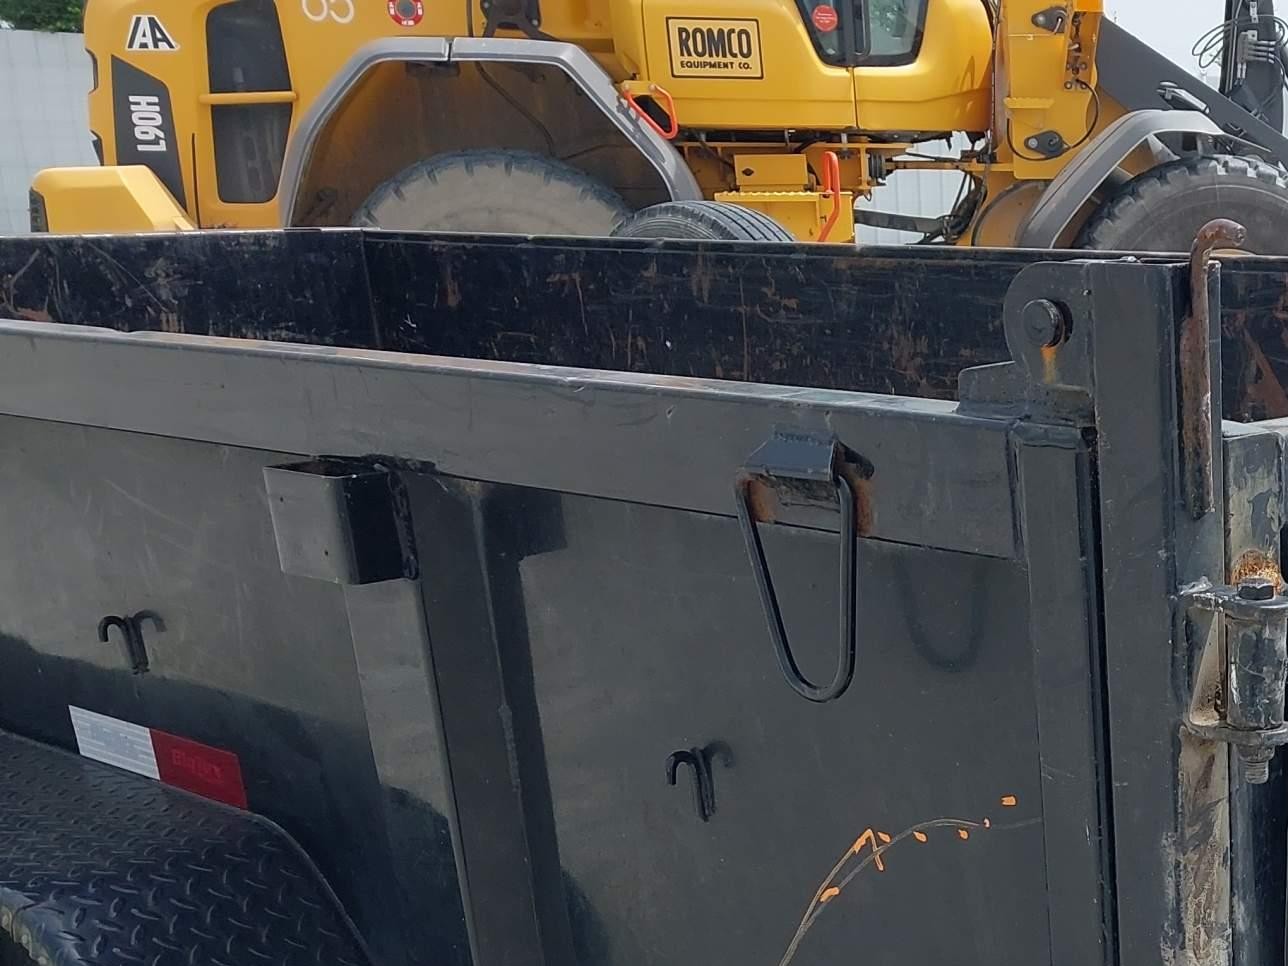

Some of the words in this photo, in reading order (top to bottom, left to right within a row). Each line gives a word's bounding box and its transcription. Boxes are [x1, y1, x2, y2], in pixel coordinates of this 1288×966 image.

[677, 26, 753, 59] ROMCO
[680, 61, 734, 70] EQUIPMENT
[738, 62, 752, 70] CO.
[128, 95, 167, 152] L90H
